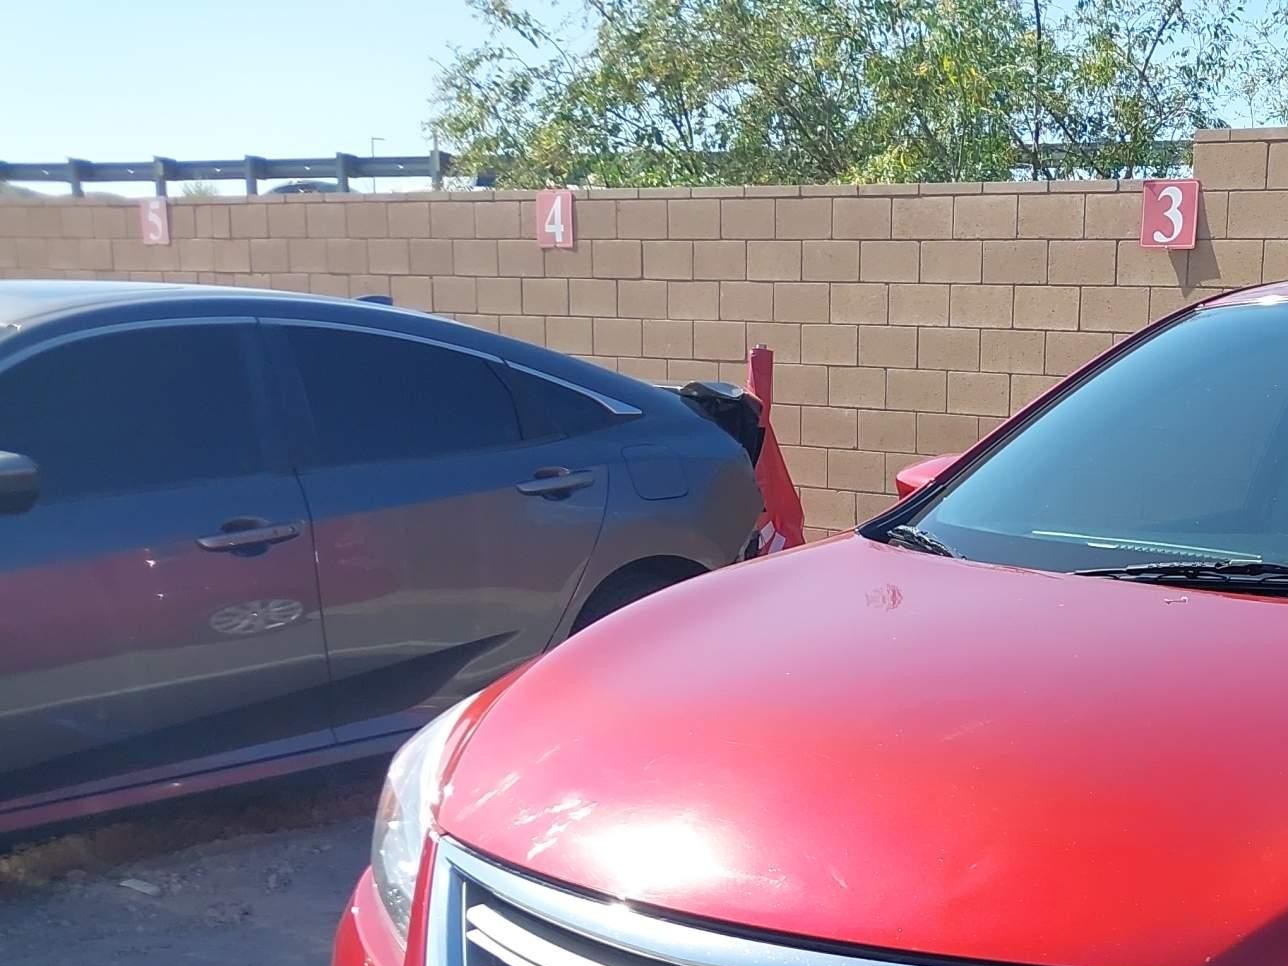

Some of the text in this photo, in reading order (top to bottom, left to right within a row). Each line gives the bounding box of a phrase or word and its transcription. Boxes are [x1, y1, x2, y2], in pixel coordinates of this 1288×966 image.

[148, 201, 163, 241] 5
[544, 195, 564, 243] 4
[1152, 186, 1184, 243] 3
